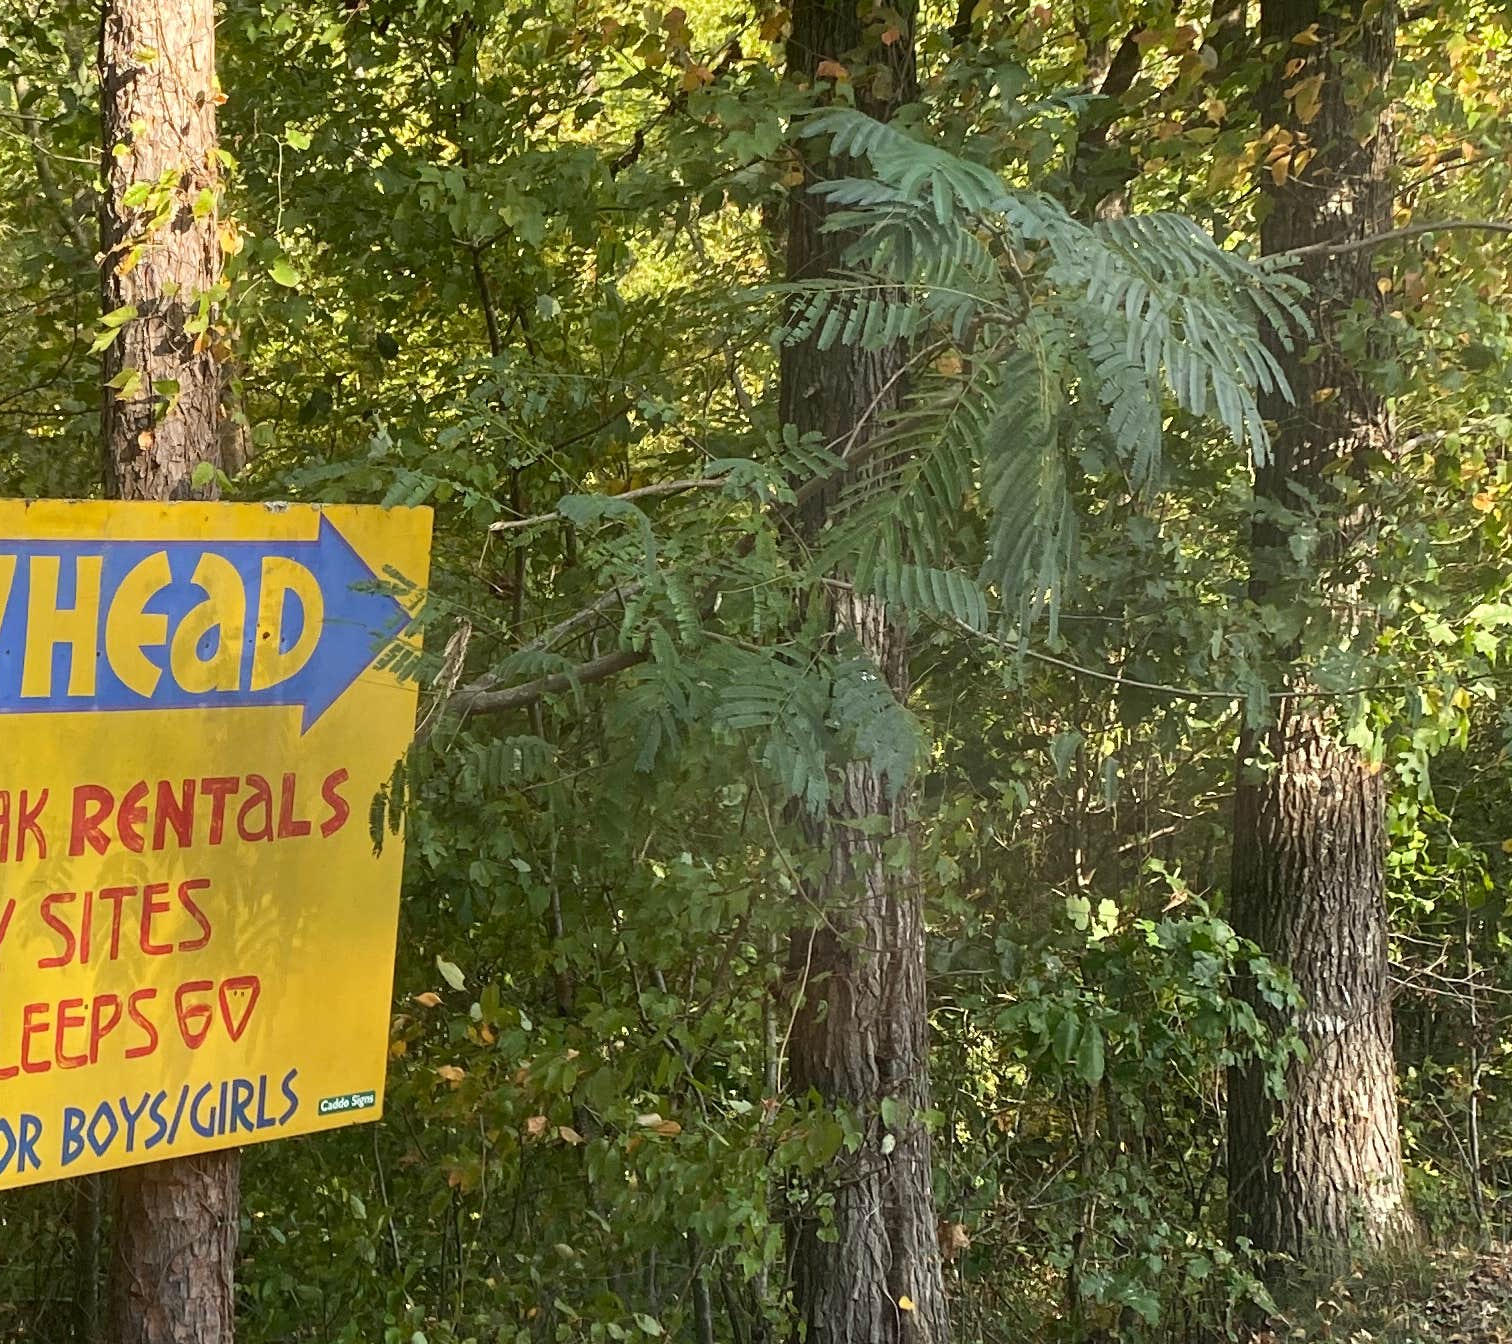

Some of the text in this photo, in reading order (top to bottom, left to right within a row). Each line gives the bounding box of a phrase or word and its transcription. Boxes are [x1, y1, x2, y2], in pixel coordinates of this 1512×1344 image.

[38, 879, 212, 969] SITES
[174, 975, 260, 1050] 60
[61, 1068, 299, 1166] BOYS/GIRLS
[320, 1094, 374, 1112] Caddo Signs
